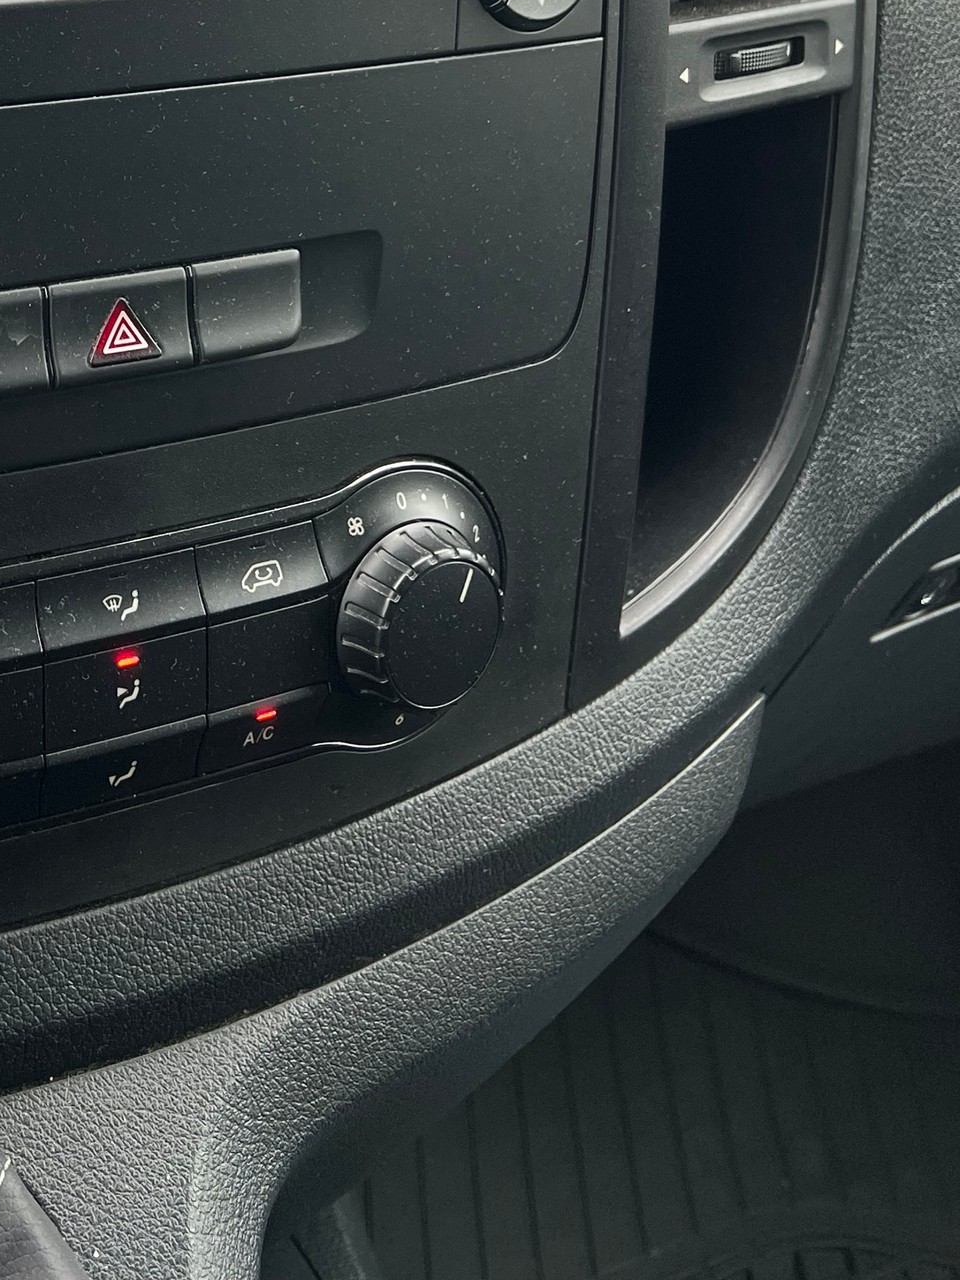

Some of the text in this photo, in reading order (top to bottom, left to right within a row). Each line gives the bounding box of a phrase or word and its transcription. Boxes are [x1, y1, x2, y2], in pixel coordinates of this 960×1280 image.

[396, 491, 407, 510] 0
[441, 493, 449, 510] 1
[472, 524, 480, 543] 2
[394, 712, 405, 726] 6
[242, 725, 275, 747] A/C
